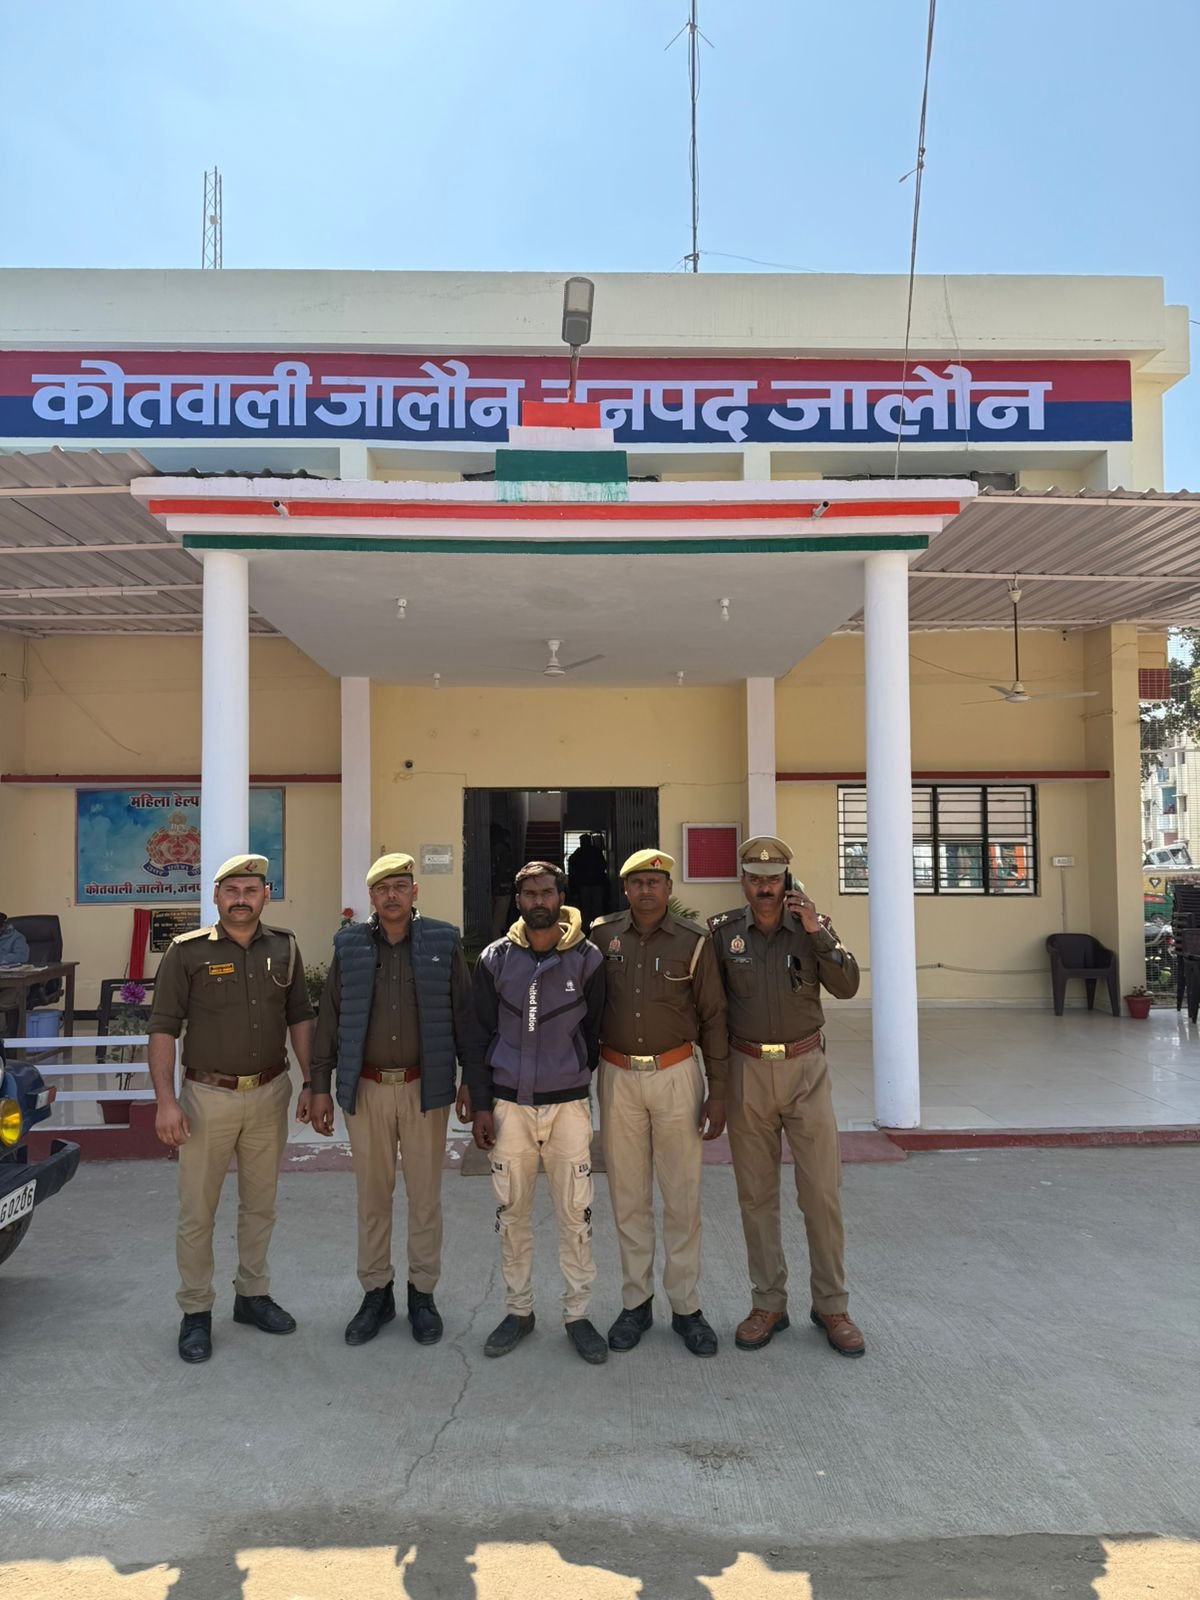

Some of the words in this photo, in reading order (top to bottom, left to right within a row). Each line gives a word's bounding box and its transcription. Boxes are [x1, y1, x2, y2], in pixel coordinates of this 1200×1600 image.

[32, 360, 312, 429] कोतवाली
[314, 360, 525, 431] जालौन
[768, 364, 1053, 435] जालौन
[130, 793, 170, 808] महिला
[86, 881, 133, 895] कोतवाली
